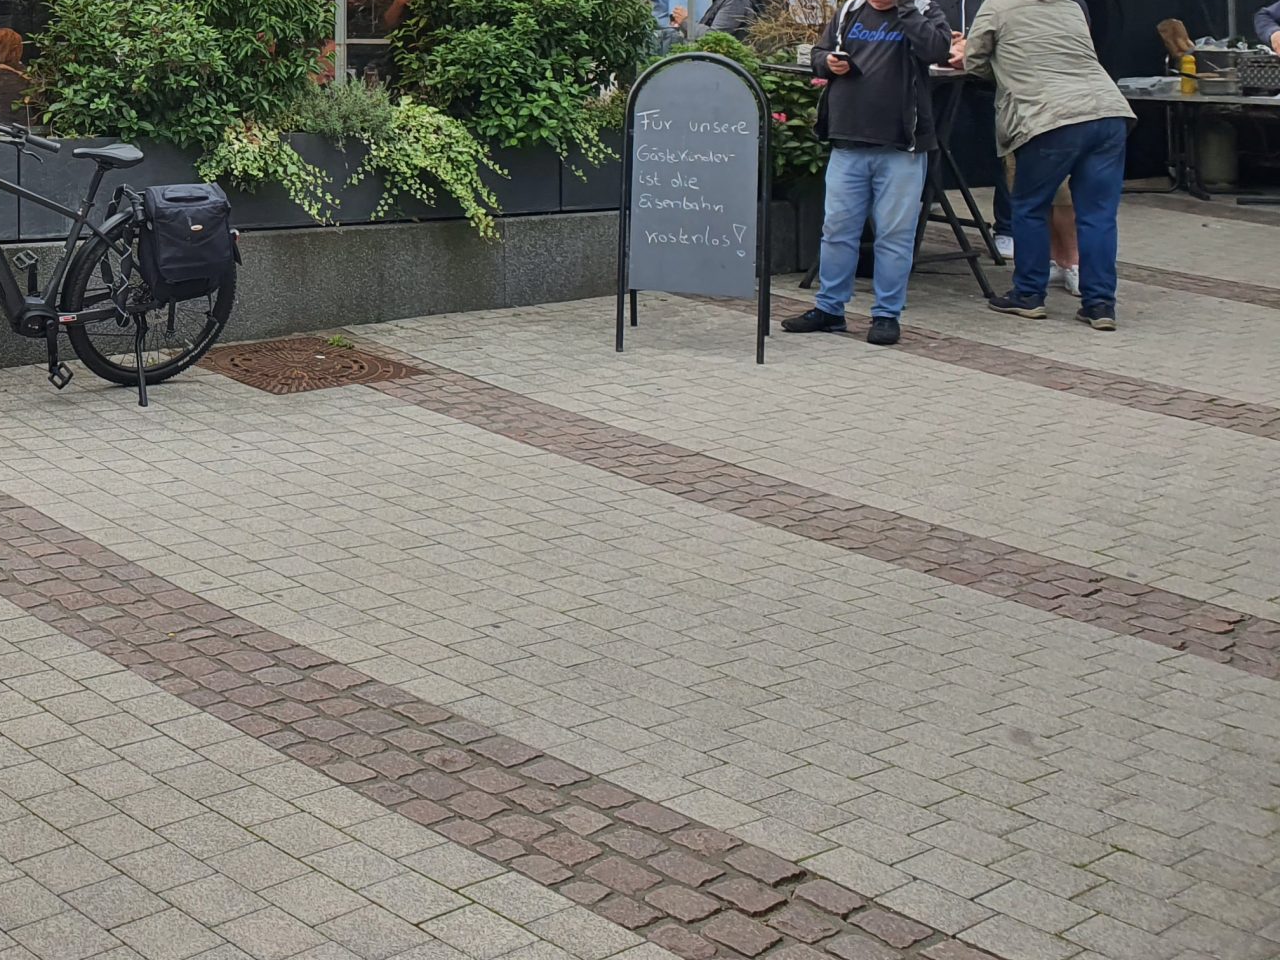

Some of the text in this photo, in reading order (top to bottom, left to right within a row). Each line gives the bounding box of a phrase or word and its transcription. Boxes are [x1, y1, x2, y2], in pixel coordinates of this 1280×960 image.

[636, 109, 751, 135] Für unsere
[639, 170, 700, 190] ist die
[638, 193, 724, 213] Eisenbahn
